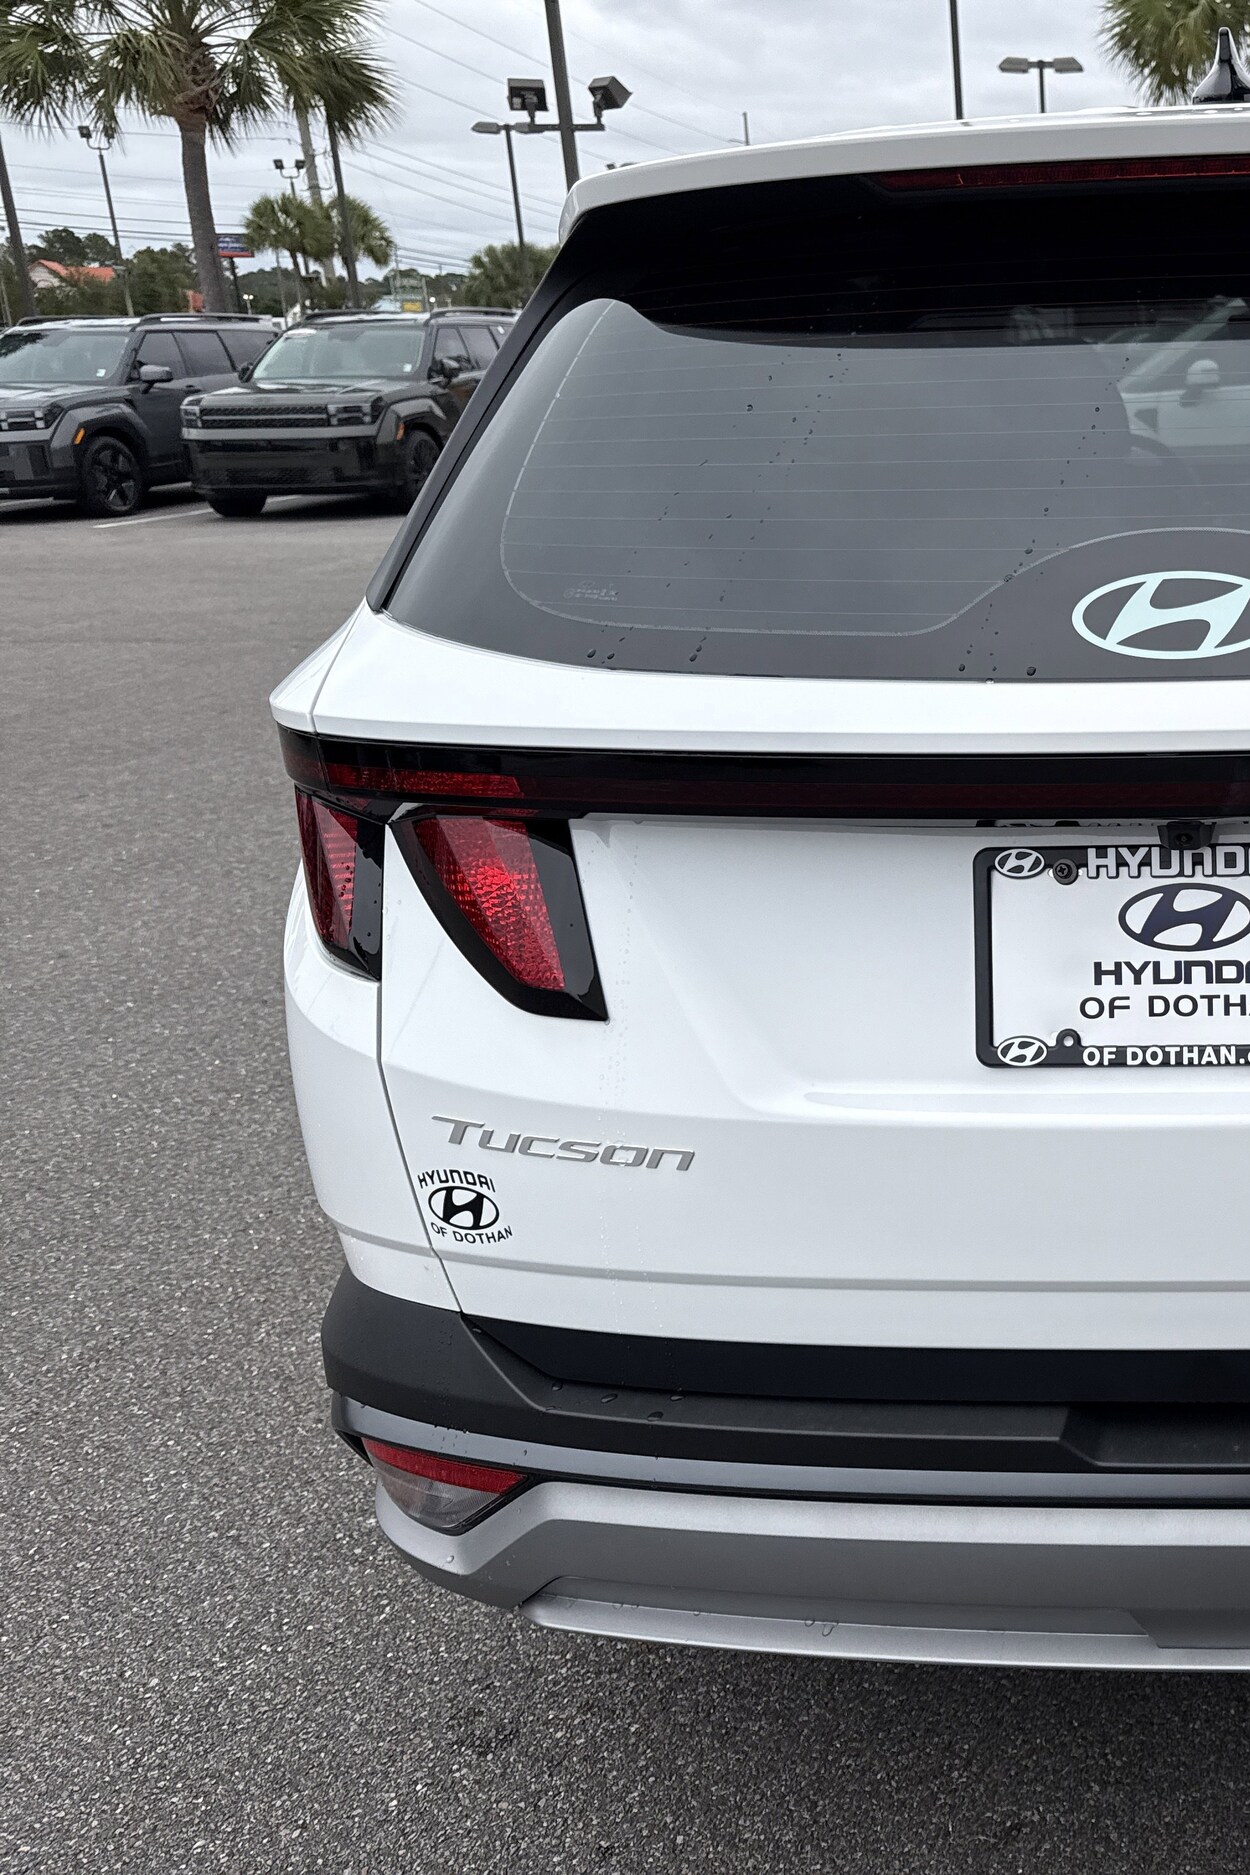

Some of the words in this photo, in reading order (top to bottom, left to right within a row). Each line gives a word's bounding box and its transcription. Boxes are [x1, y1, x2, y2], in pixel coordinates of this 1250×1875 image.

[1079, 996, 1131, 1019] OF
[1082, 1046, 1117, 1066] OF
[417, 1168, 496, 1193] HYUNDAI
[430, 1221, 448, 1238] OF
[452, 1225, 513, 1245] DOTHAN
